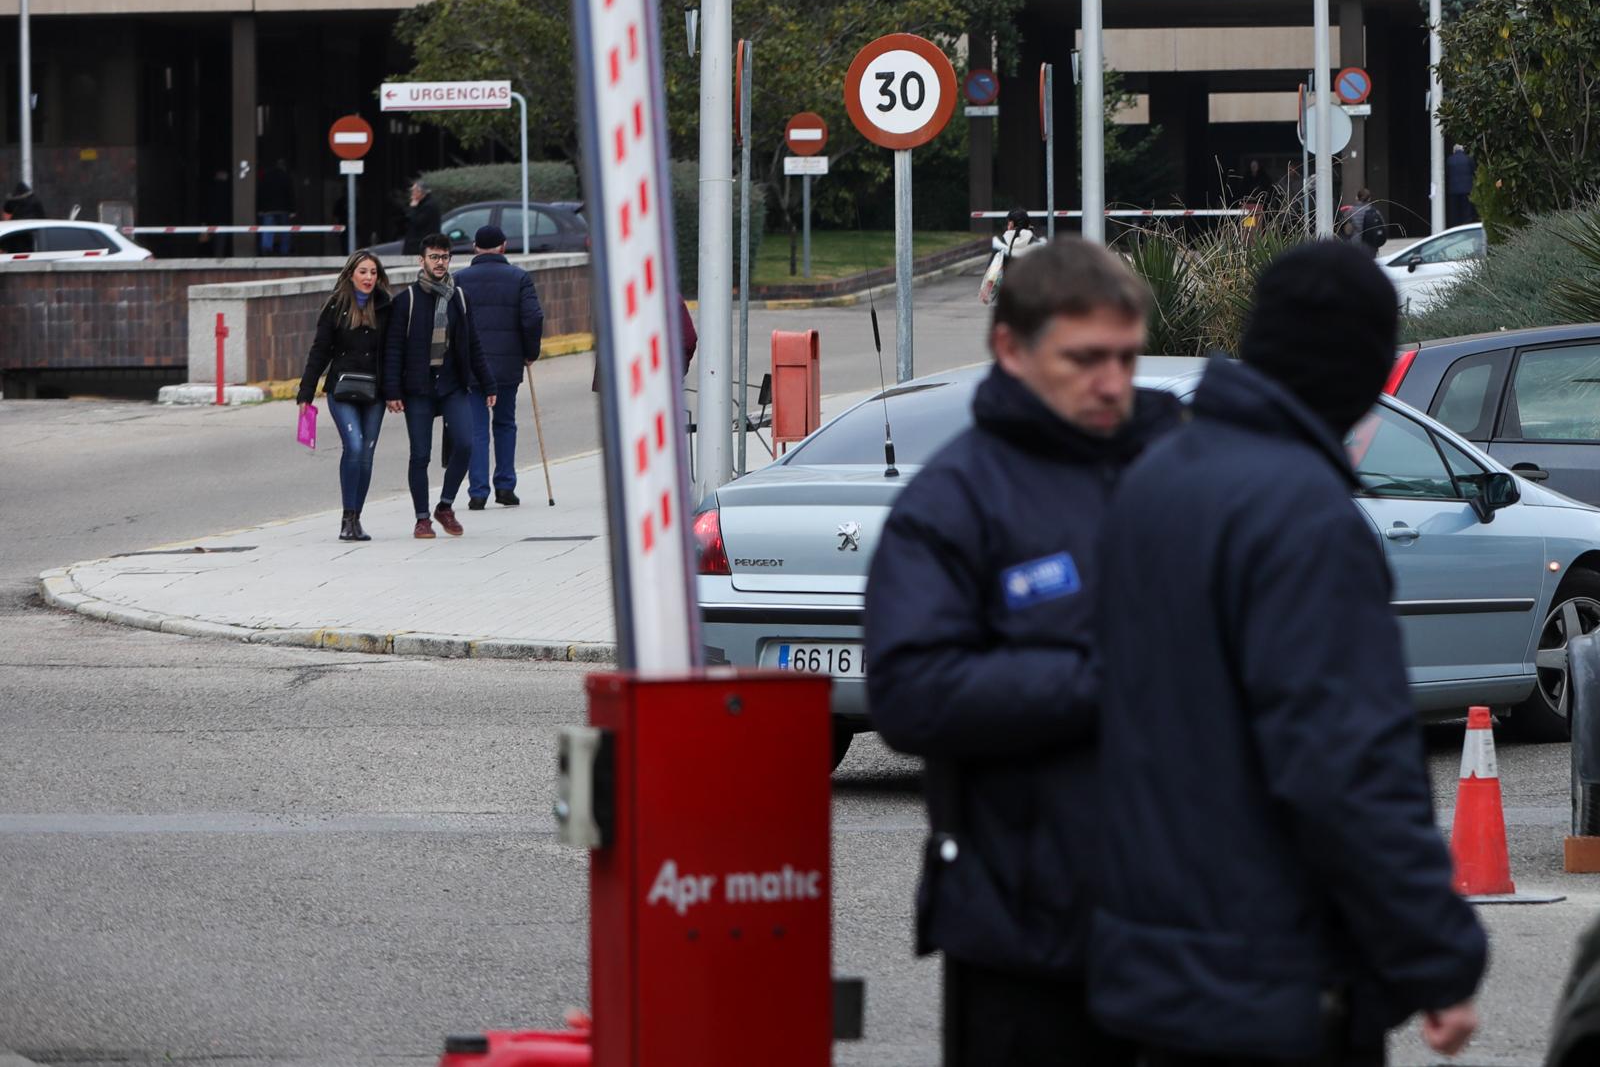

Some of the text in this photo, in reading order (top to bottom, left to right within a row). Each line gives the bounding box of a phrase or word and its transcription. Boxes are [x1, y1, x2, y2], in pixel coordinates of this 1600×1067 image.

[409, 87, 509, 102] URGENCIAS
[874, 70, 926, 113] 30
[734, 558, 784, 567] PEUGEOT
